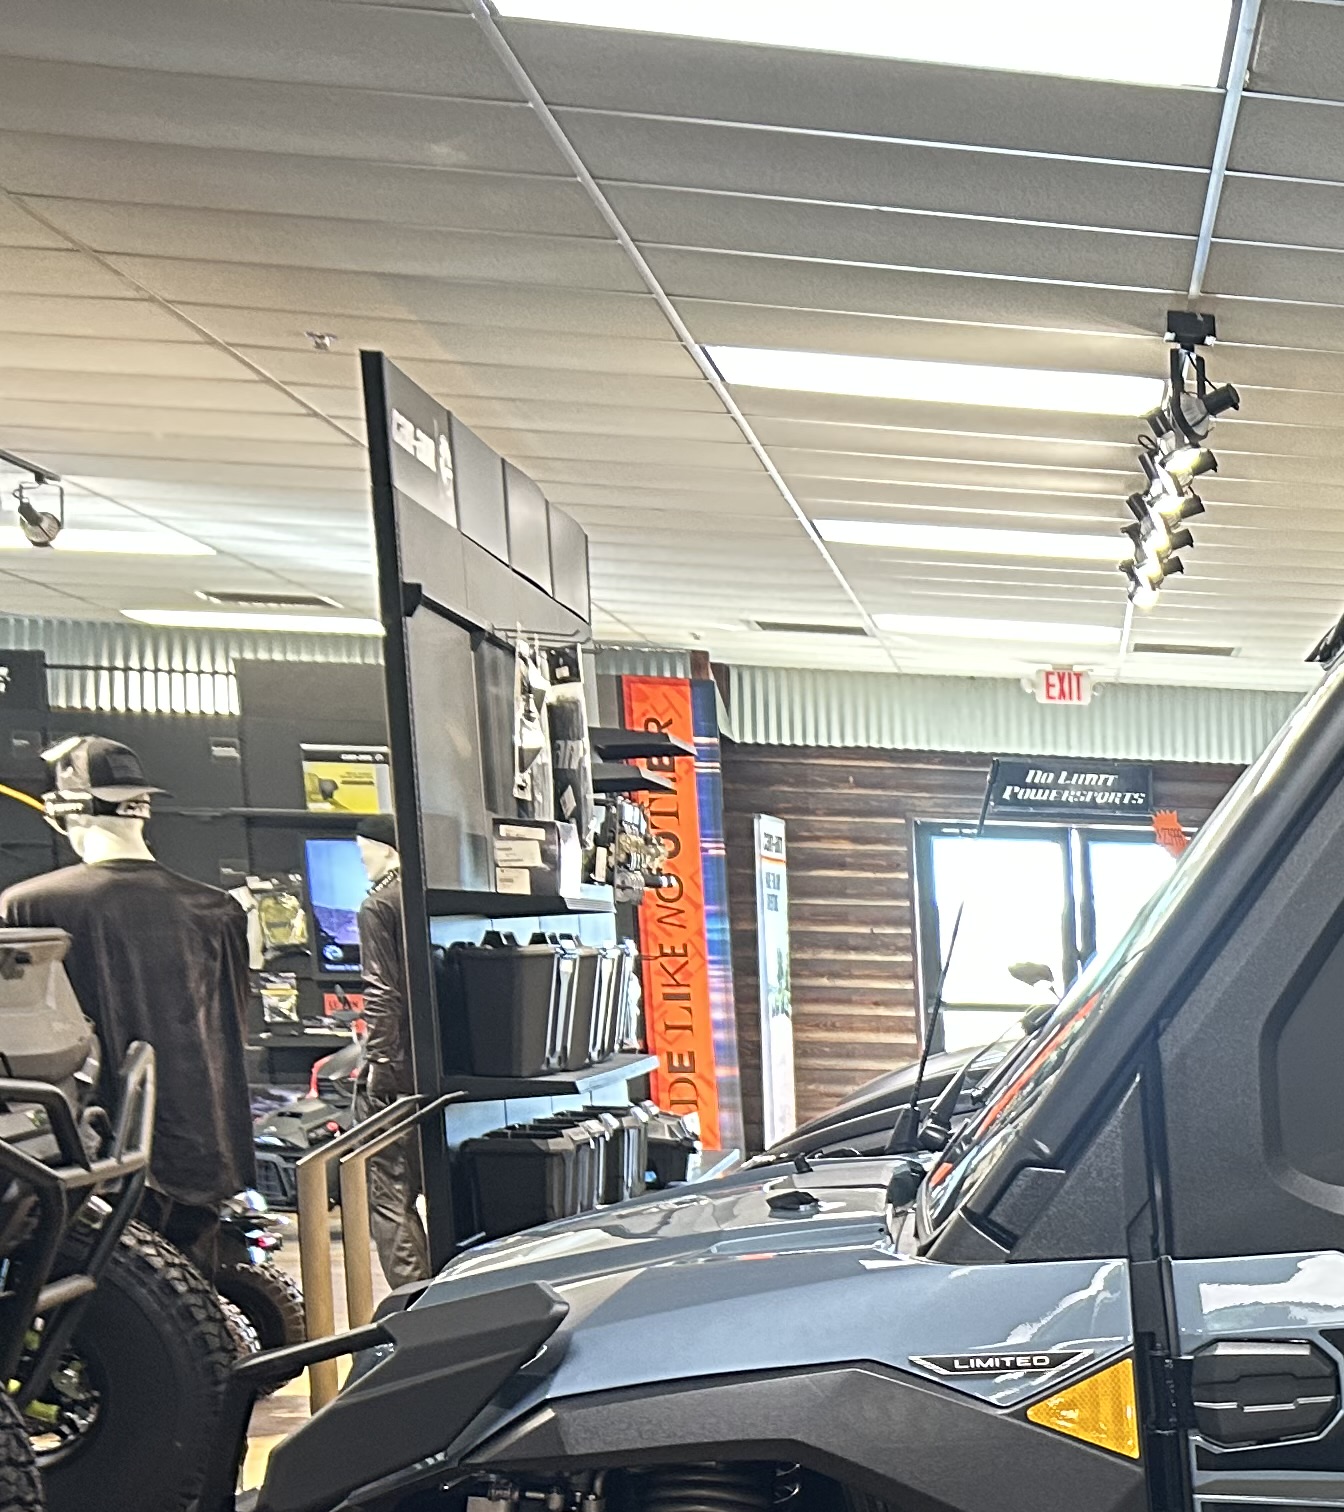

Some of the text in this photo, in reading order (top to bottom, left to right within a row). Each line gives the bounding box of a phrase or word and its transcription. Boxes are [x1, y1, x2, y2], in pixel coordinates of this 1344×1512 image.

[1046, 671, 1083, 701] EXIT
[643, 716, 698, 1109] DE LIKE NO OTER
[953, 1355, 1050, 1369] LIMITED
